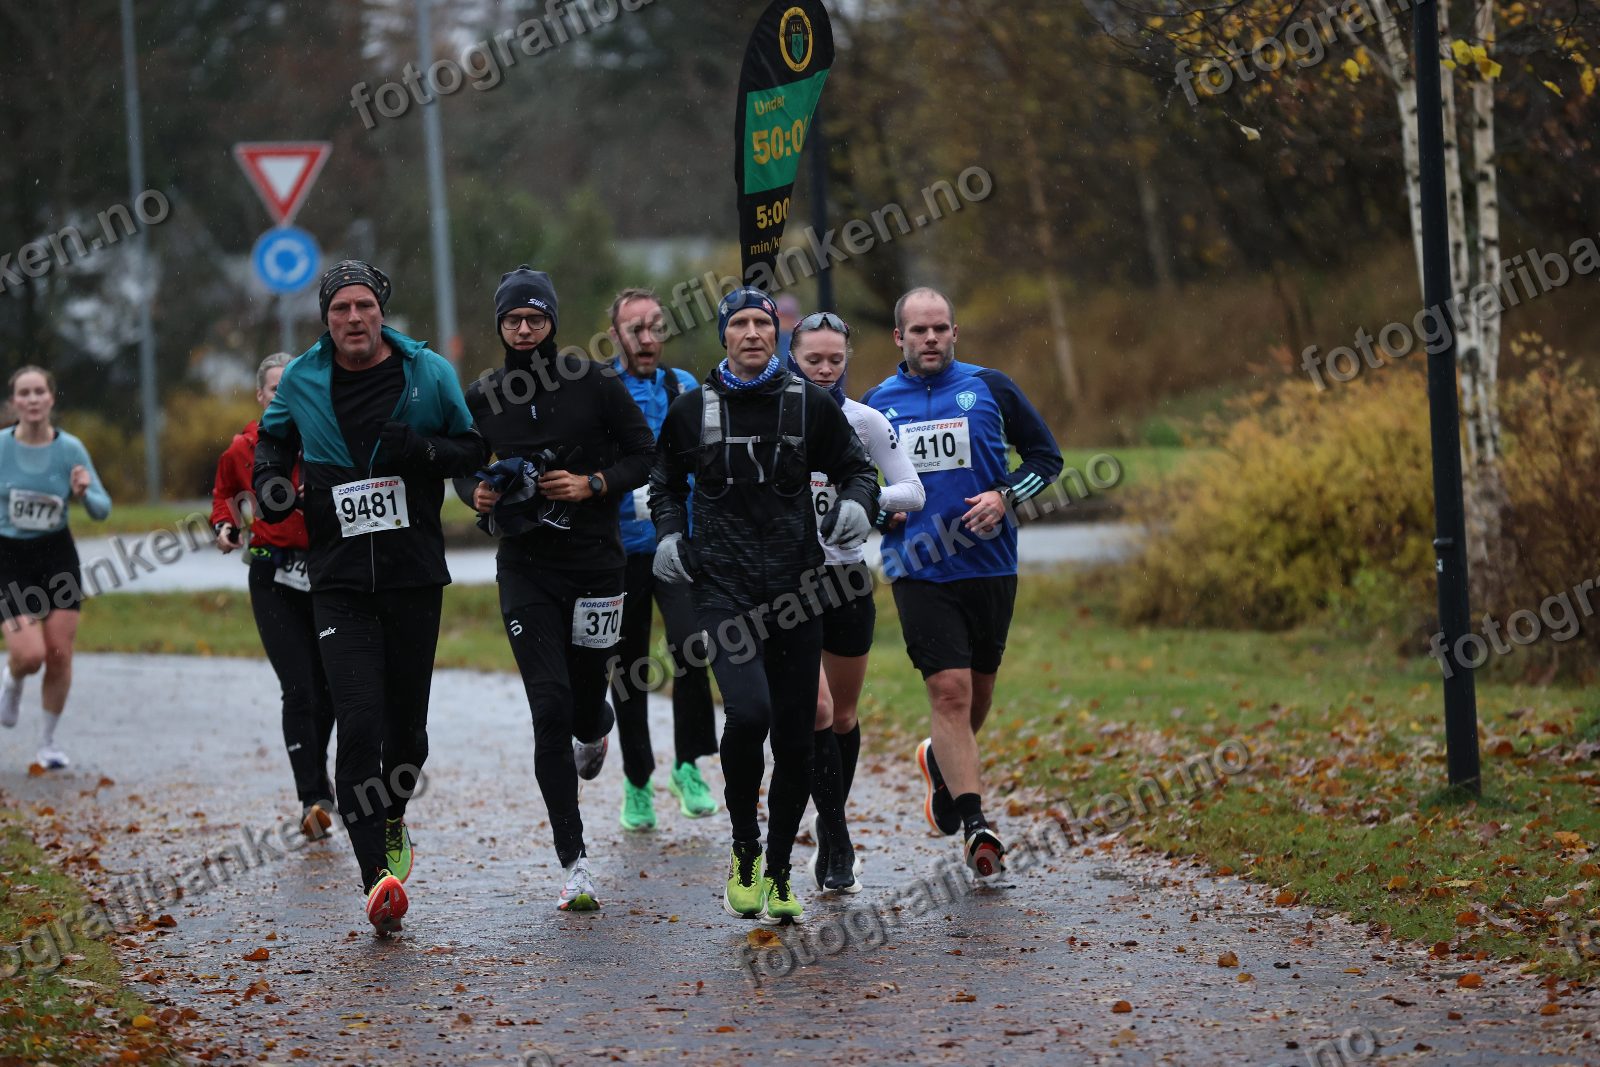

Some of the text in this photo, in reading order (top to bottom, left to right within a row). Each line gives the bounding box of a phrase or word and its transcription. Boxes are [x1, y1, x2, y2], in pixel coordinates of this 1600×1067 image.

[754, 95, 785, 117] Under
[756, 197, 790, 230] 5:00
[750, 235, 783, 256] min/k
[905, 421, 964, 434] NORGESTESTEN
[914, 432, 957, 460] 410
[14, 500, 59, 519] 9477
[341, 489, 398, 524] 9481
[586, 609, 619, 637] 370
